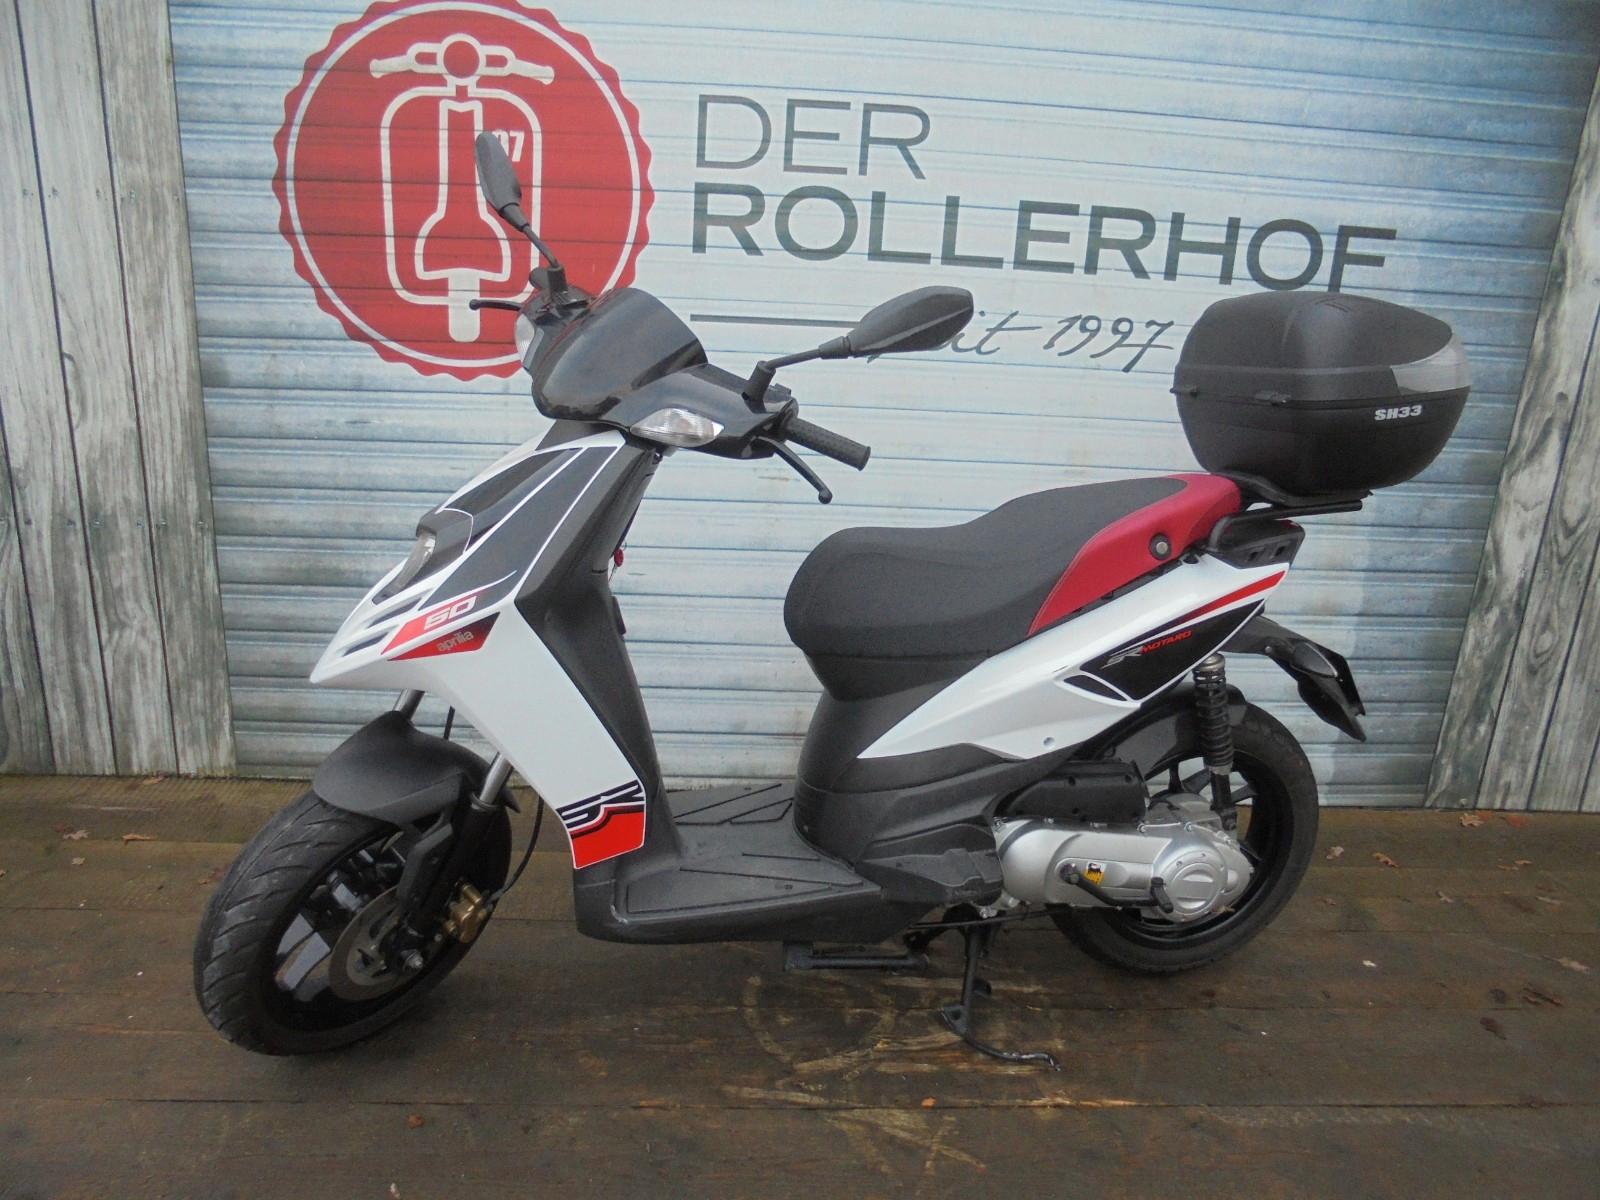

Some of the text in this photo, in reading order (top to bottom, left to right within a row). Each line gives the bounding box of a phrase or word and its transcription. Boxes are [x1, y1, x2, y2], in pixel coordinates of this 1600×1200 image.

[696, 94, 931, 180] DER
[692, 182, 1397, 292] ROLLERHOF
[1043, 314, 1174, 373] 1997
[1374, 404, 1423, 421] SH33
[424, 595, 477, 631] 50
[436, 630, 474, 652] aprilia
